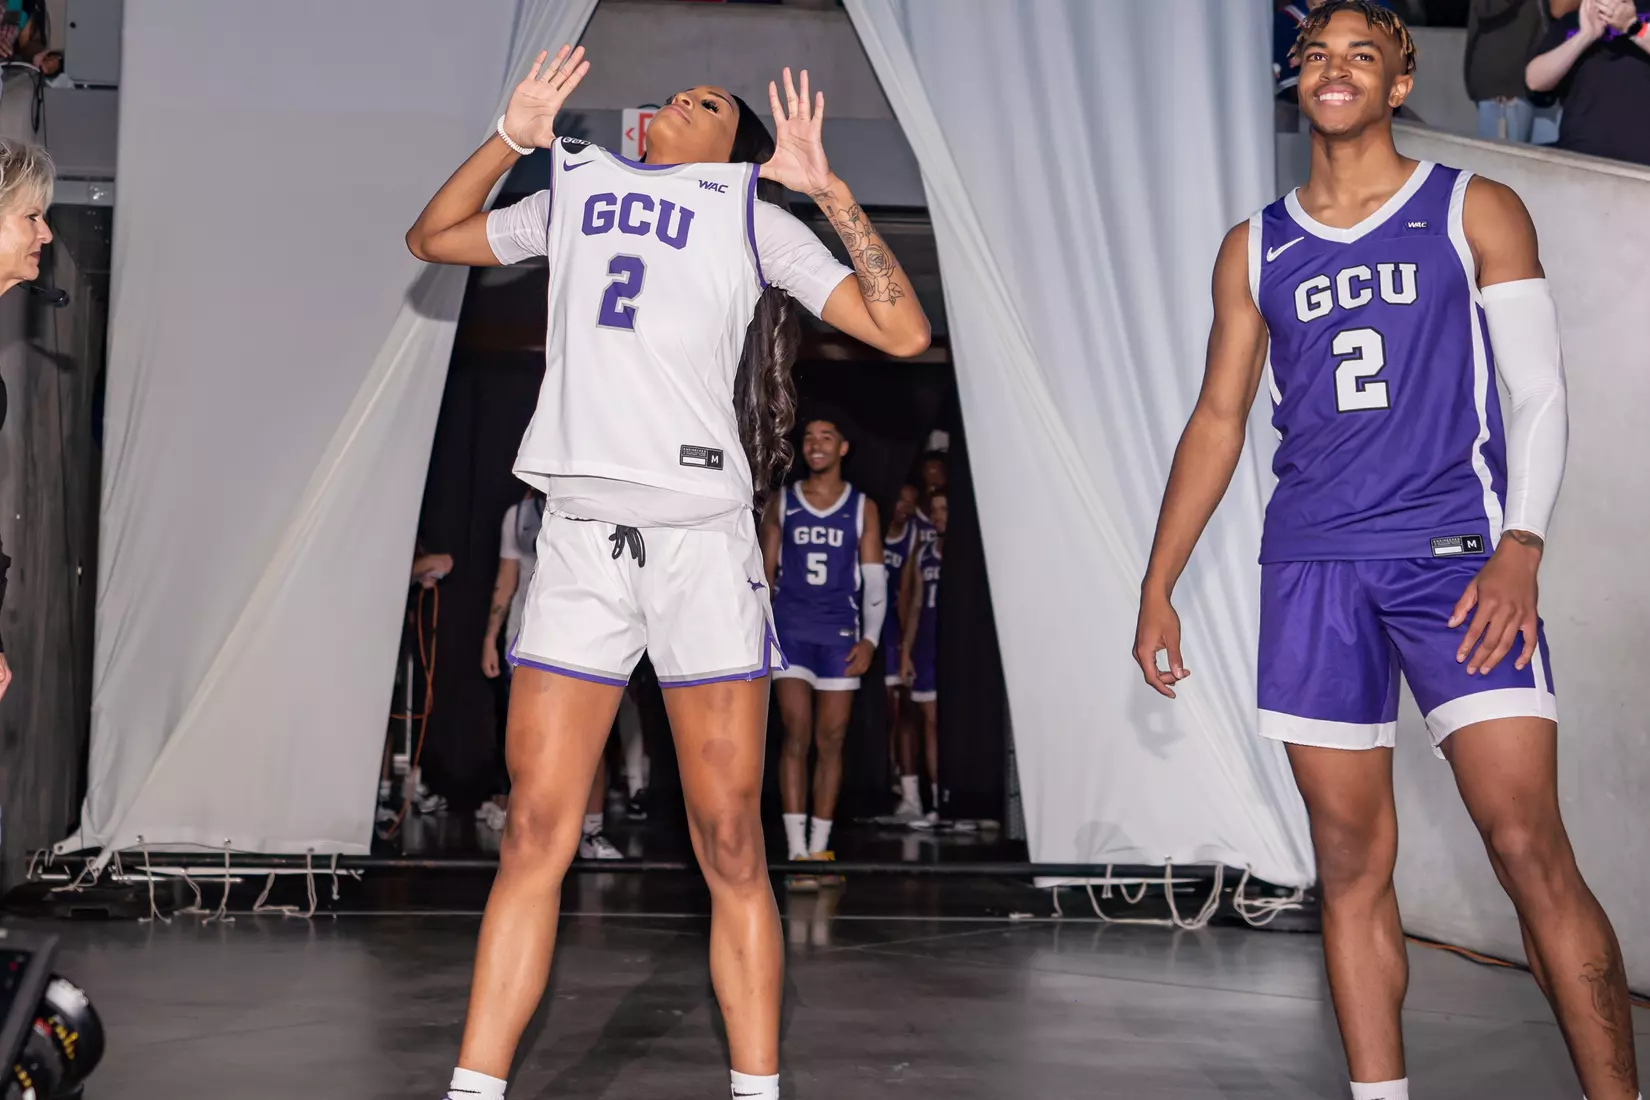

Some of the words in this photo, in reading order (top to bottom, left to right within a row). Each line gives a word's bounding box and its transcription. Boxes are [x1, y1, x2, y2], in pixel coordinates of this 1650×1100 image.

[699, 179, 729, 194] WAC
[581, 192, 695, 250] GCU
[596, 252, 648, 332] 2
[1294, 262, 1418, 323] GCU
[1331, 326, 1391, 414] 2
[710, 454, 719, 464] M
[793, 526, 844, 547] GCU
[1466, 539, 1478, 549] M
[807, 552, 828, 586] 5
[883, 549, 902, 568] CU
